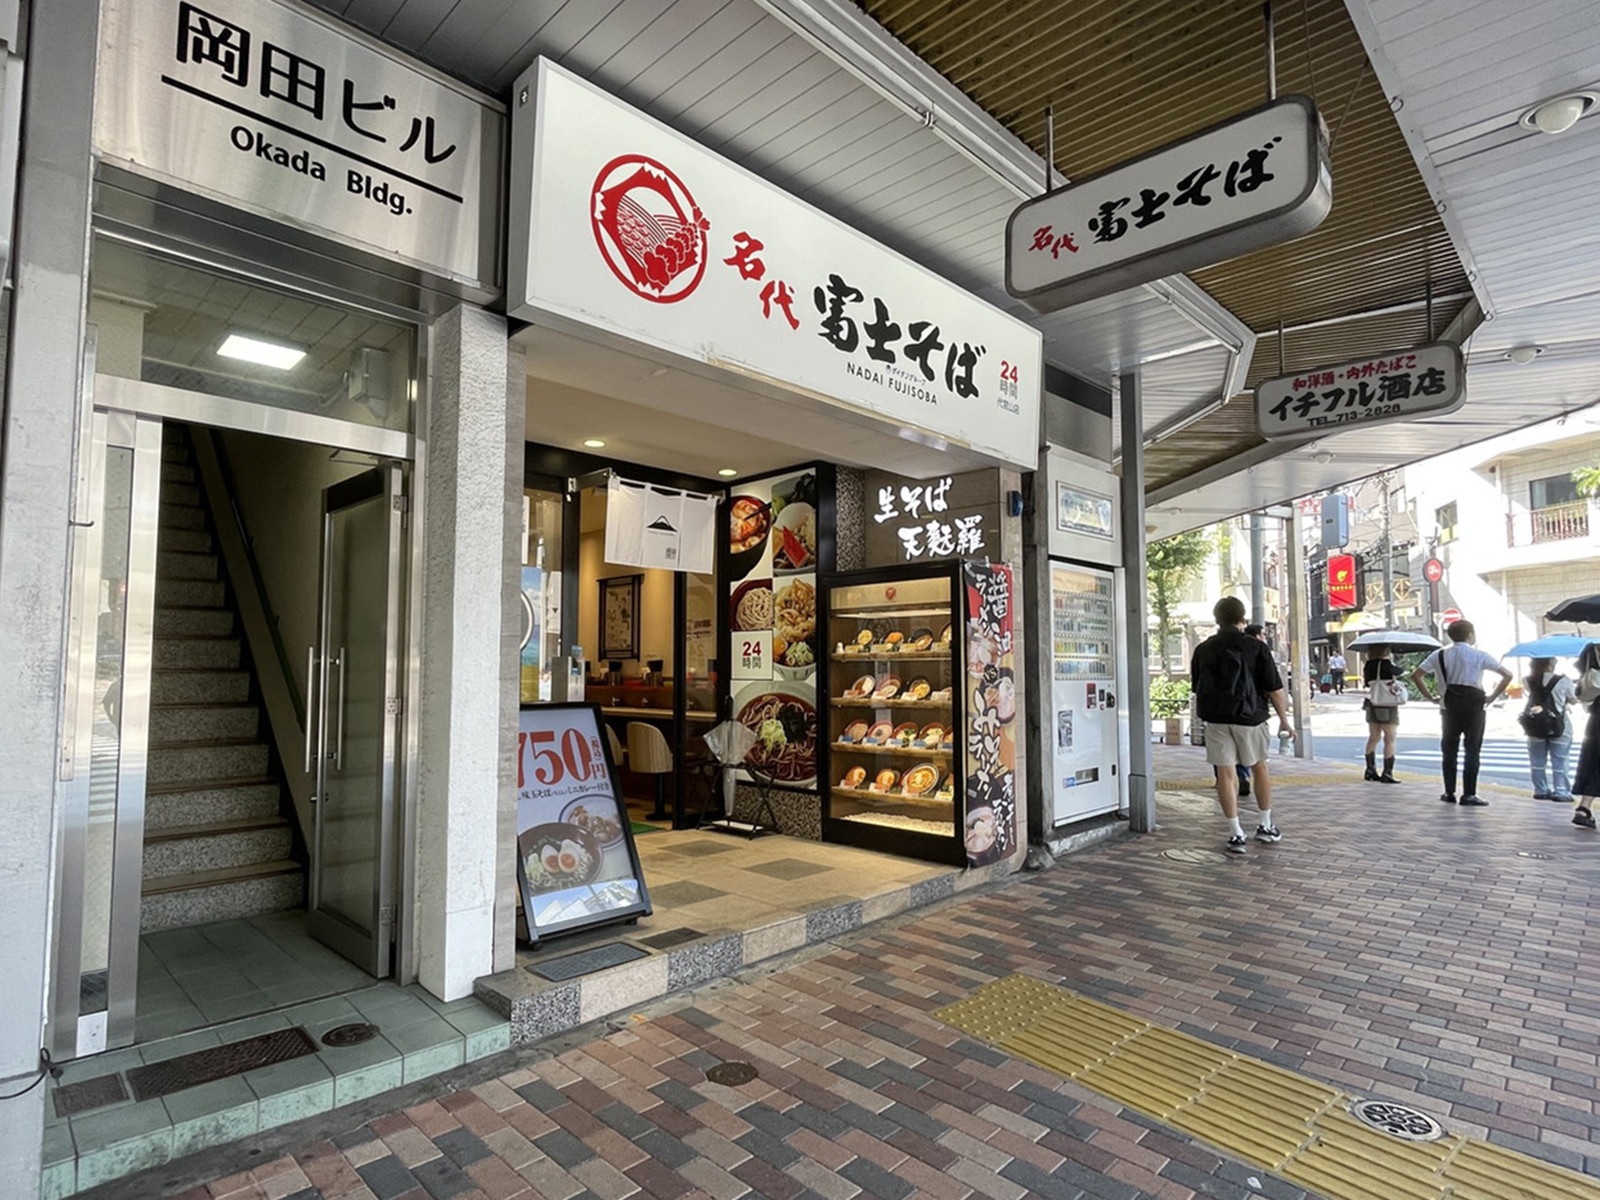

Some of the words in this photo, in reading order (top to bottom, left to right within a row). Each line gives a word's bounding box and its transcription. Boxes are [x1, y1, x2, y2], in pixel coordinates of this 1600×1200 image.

[177, 1, 456, 164] 岡田ビル
[230, 125, 326, 181] Okada
[346, 169, 413, 215] Bldg.
[1028, 225, 1080, 259] 名代
[1088, 136, 1283, 245] 富士そば
[722, 231, 800, 331] 名代
[813, 273, 987, 400] 富士そば
[846, 361, 885, 386] NADAI
[888, 377, 938, 405] FUJISOBA
[1000, 360, 1019, 384] 24
[1268, 367, 1447, 422] イチフル酒店
[1291, 354, 1418, 392] 和洋酒・内外たばこ
[873, 477, 953, 524] 生そば
[741, 656, 762, 670] 時間
[742, 640, 762, 657] 24
